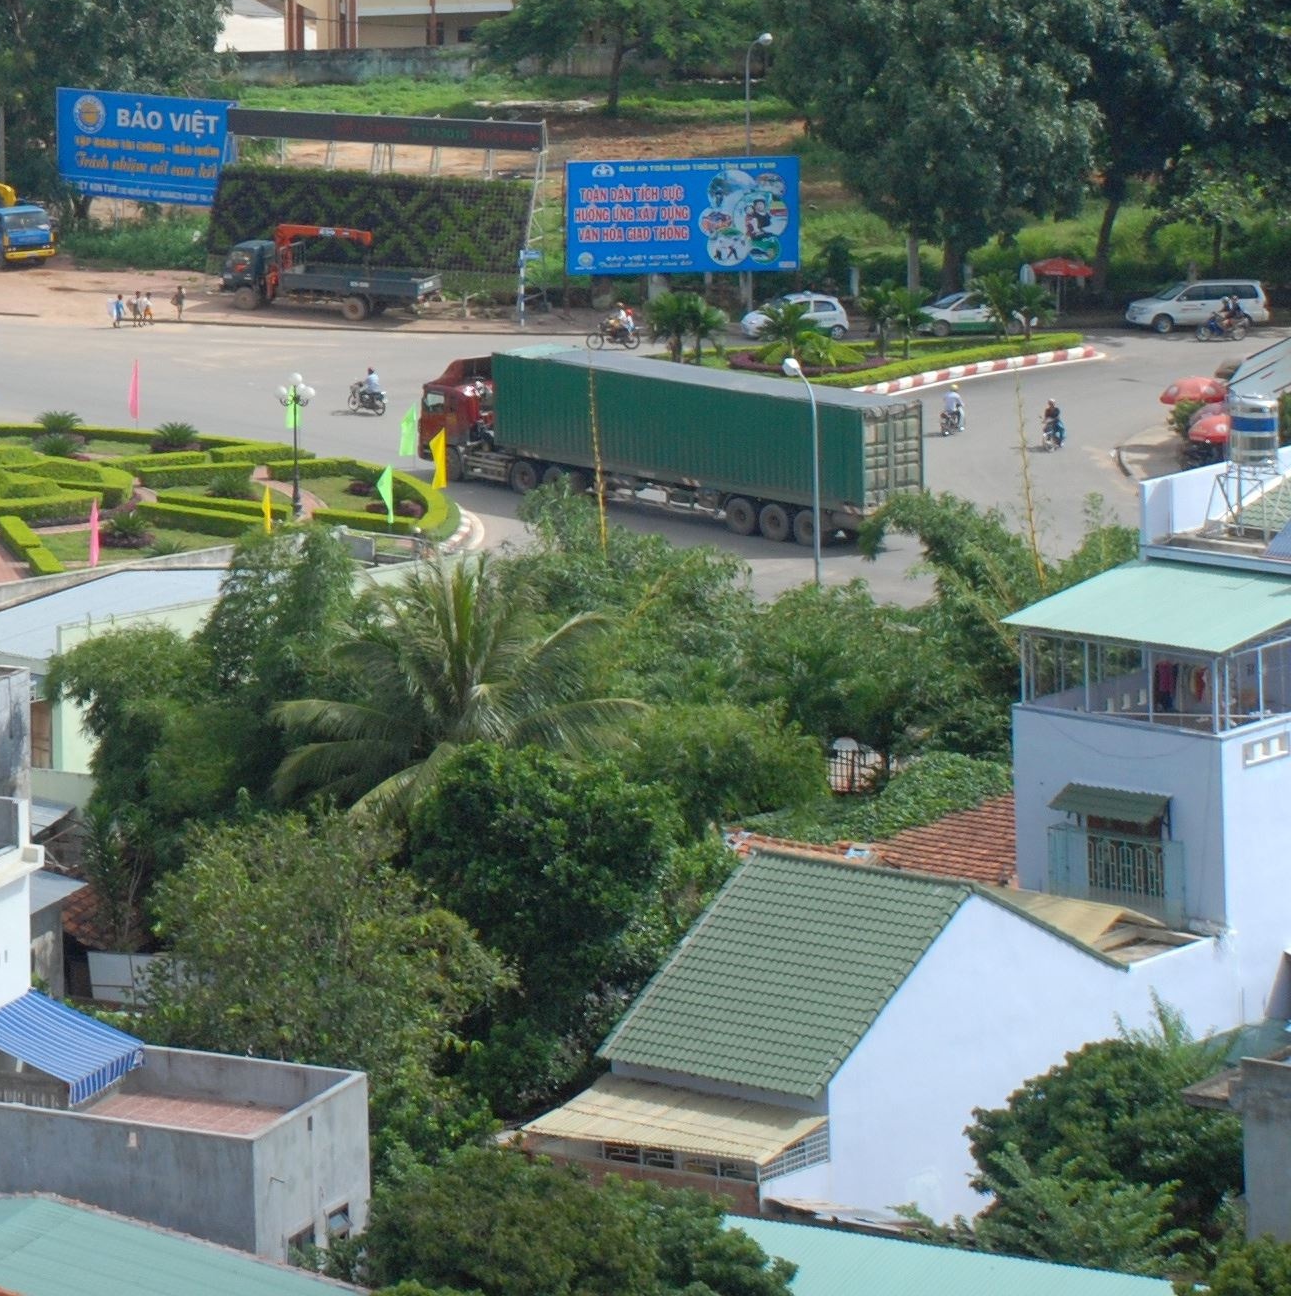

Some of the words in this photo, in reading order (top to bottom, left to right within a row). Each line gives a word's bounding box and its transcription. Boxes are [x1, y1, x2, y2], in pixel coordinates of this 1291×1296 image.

[116, 102, 163, 131] BẢO
[169, 108, 219, 139] VIỆT
[610, 183, 633, 203] DÂN
[634, 183, 660, 202] TÍCH
[626, 226, 651, 242] GIAO
[653, 222, 690, 241] THÔNG
